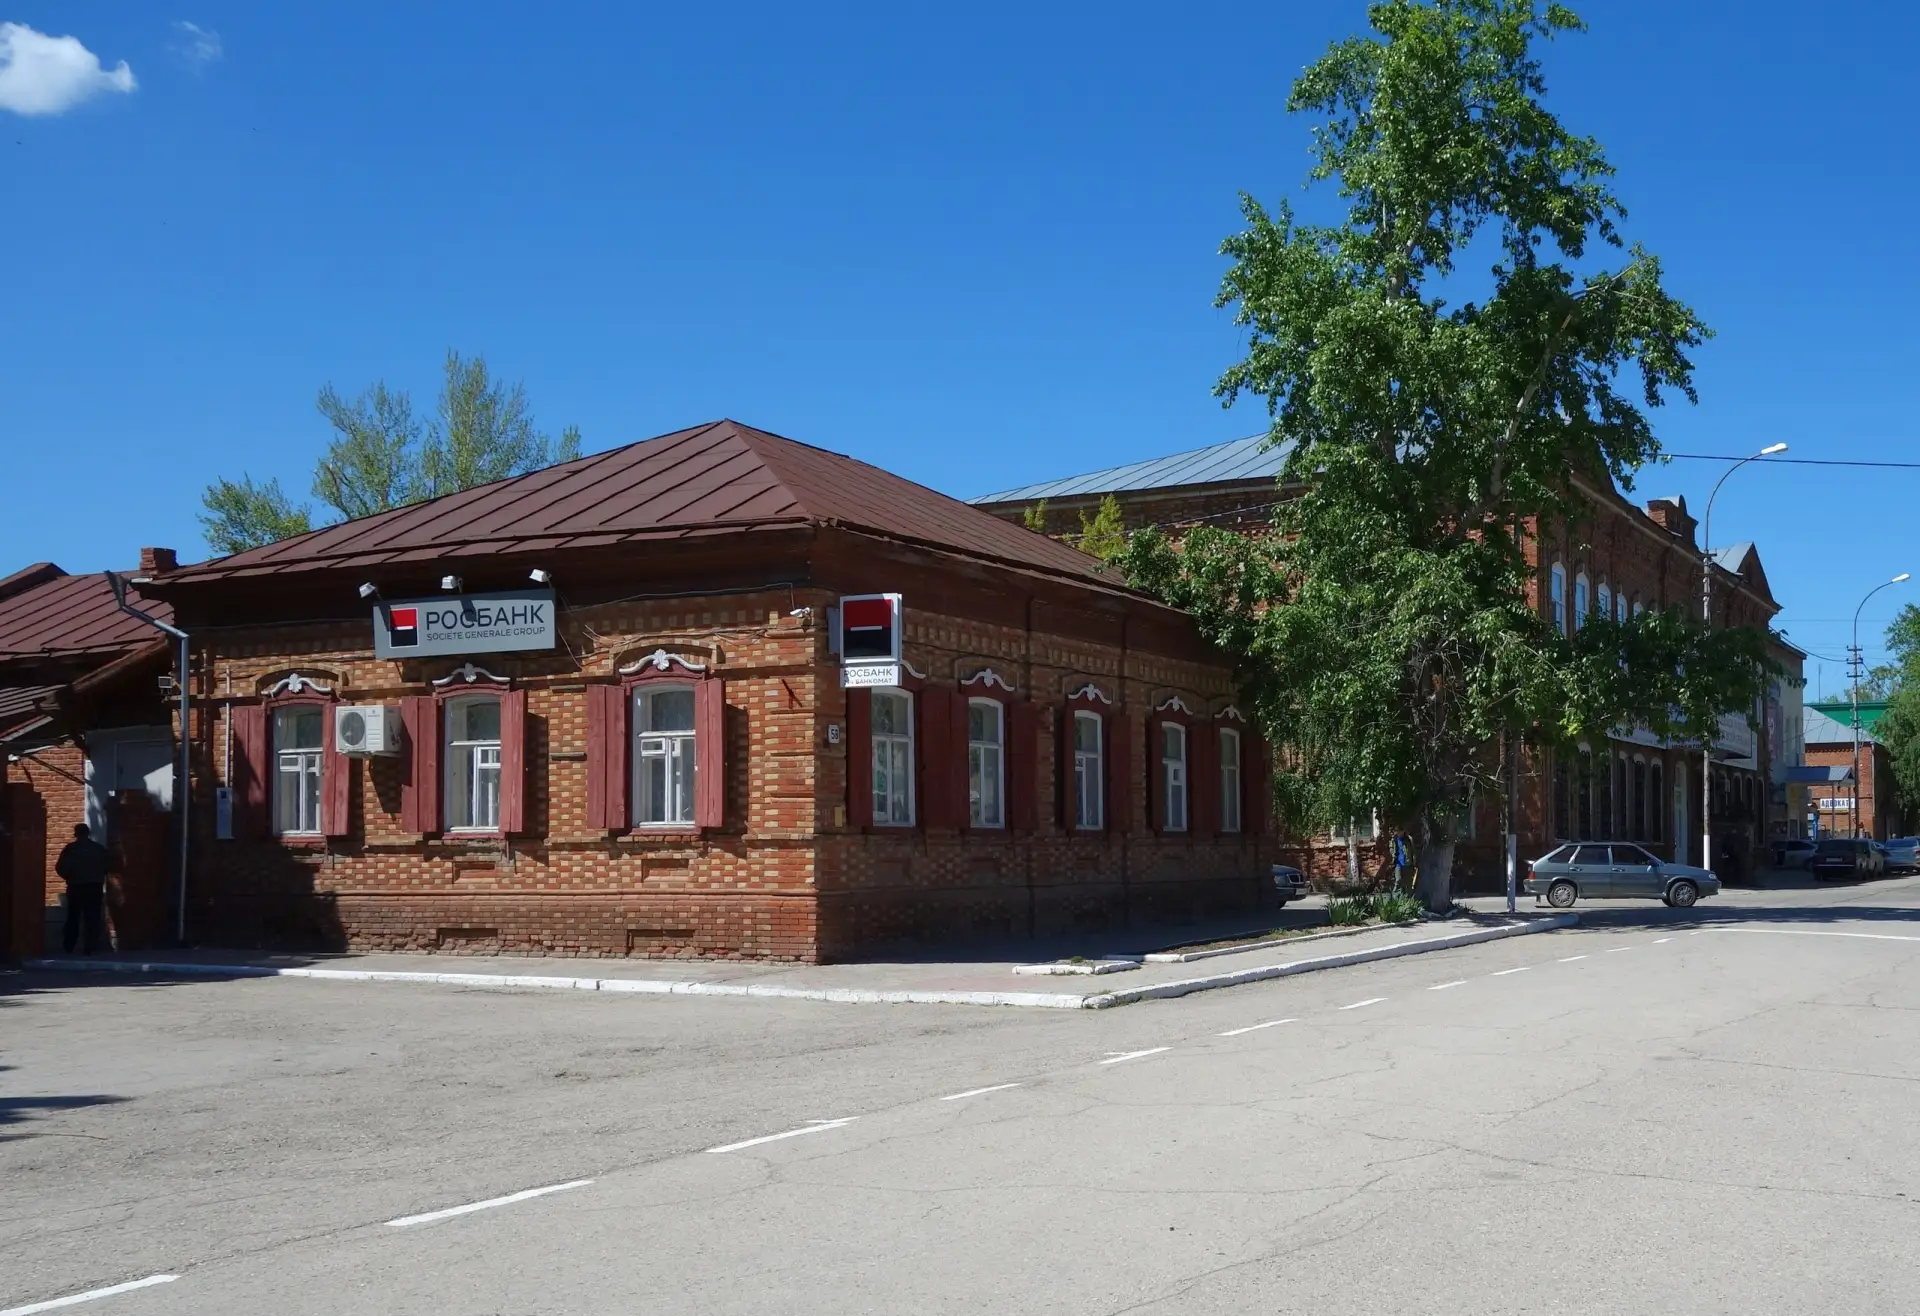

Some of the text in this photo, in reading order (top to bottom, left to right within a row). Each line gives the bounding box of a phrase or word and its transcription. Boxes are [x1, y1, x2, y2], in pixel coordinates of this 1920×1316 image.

[426, 603, 545, 630] РОСБАНК
[426, 627, 546, 641] SOCIETE GENERALE GROUP
[844, 668, 893, 678] РОСБАНК
[1821, 799, 1854, 808] АДВОКАТ
